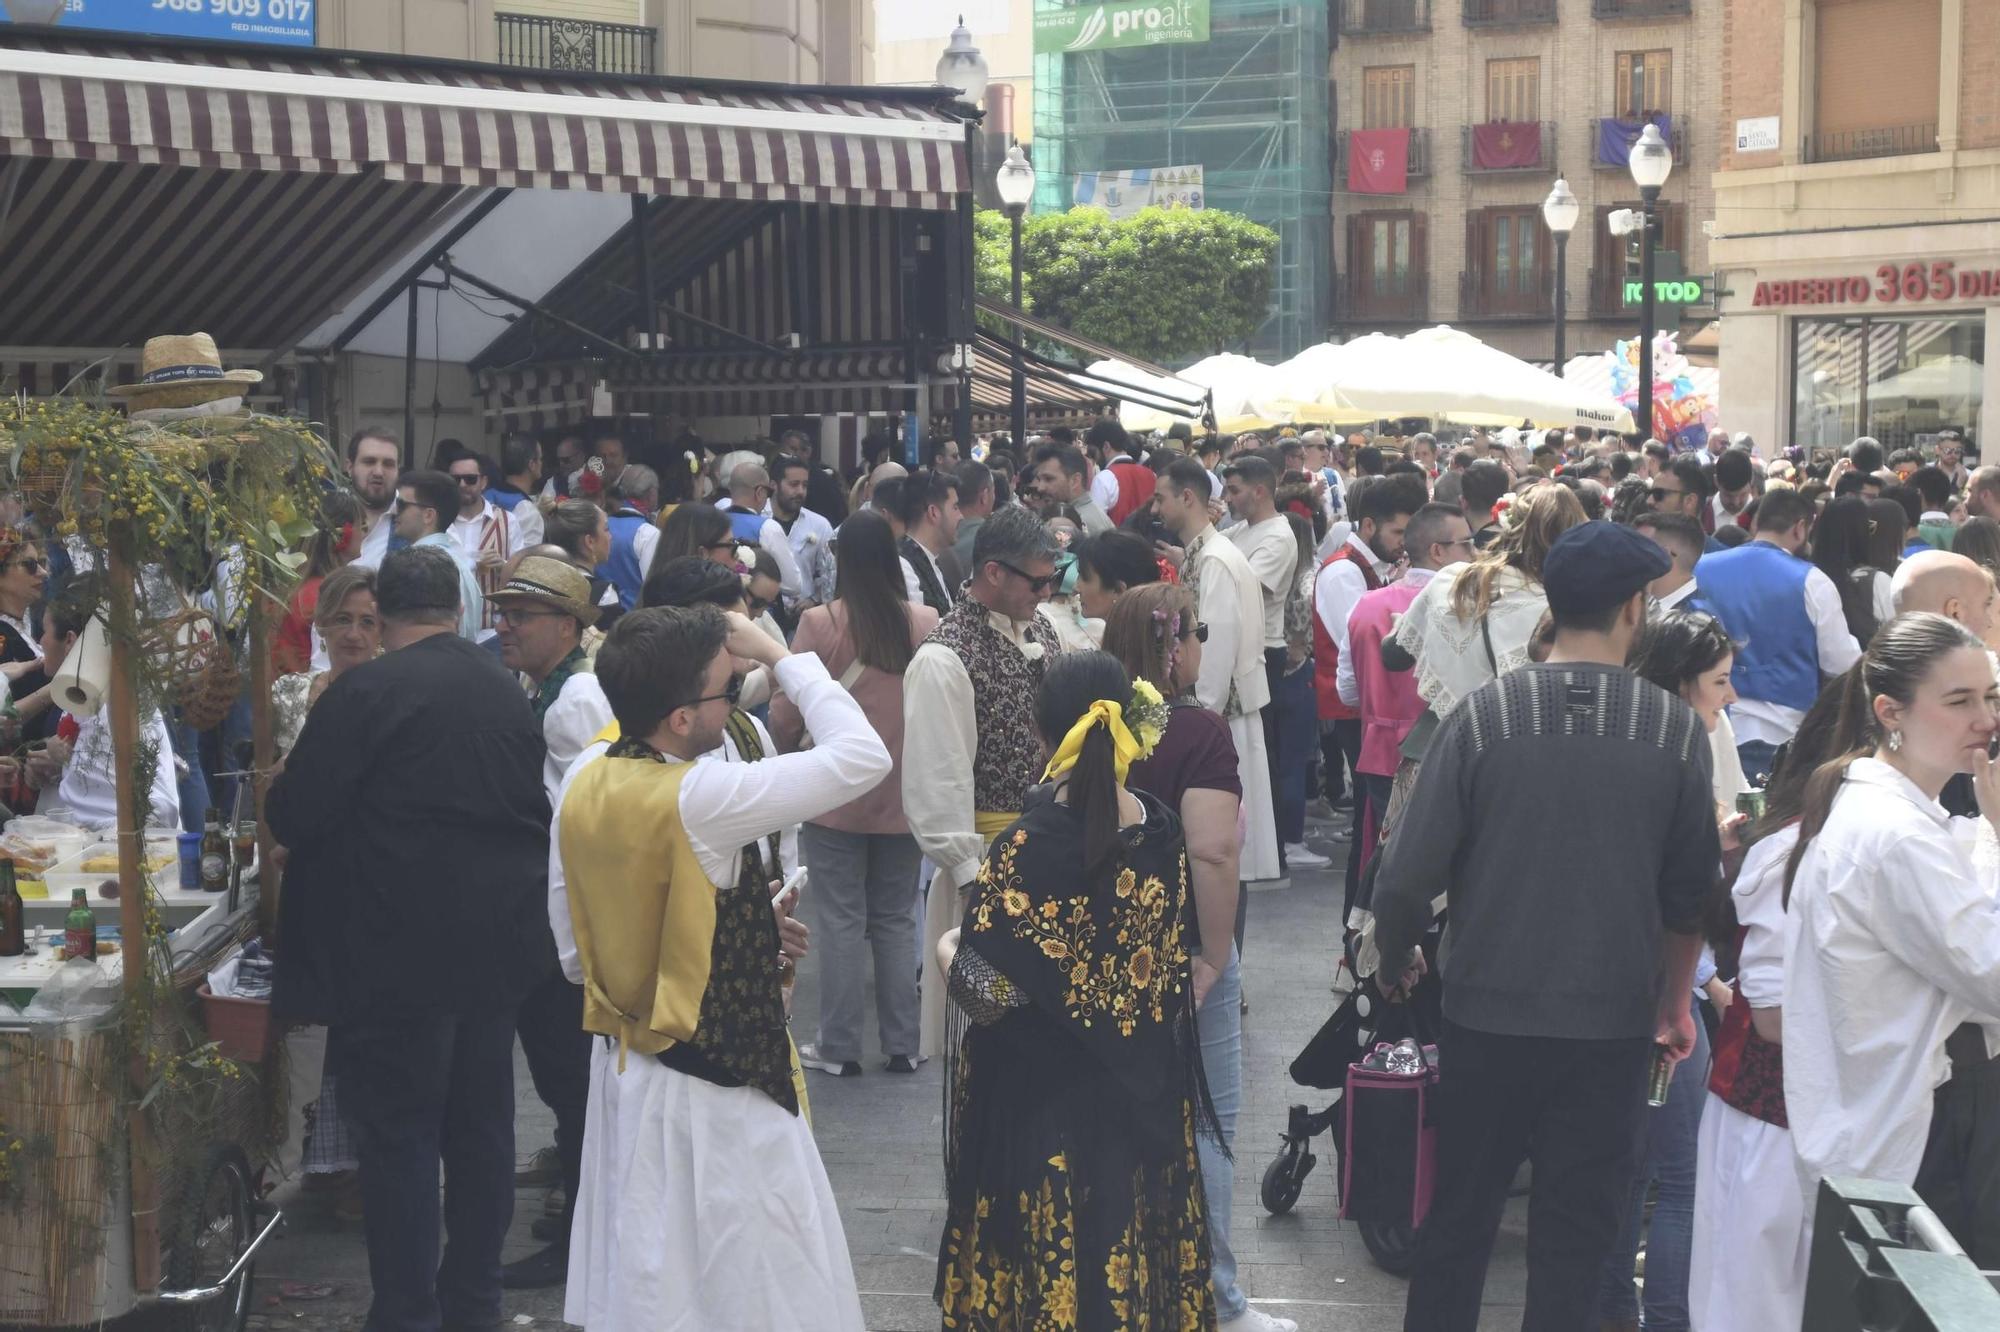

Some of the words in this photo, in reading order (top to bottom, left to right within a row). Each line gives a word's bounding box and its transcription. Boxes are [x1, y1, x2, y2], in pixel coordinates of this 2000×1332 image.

[210, 0, 260, 17] 909
[268, 0, 310, 21] 017
[231, 23, 249, 32] RED
[251, 24, 310, 36] INMOBILIARIA
[1752, 276, 1870, 306] ABIERTO
[1875, 261, 1955, 302] 365
